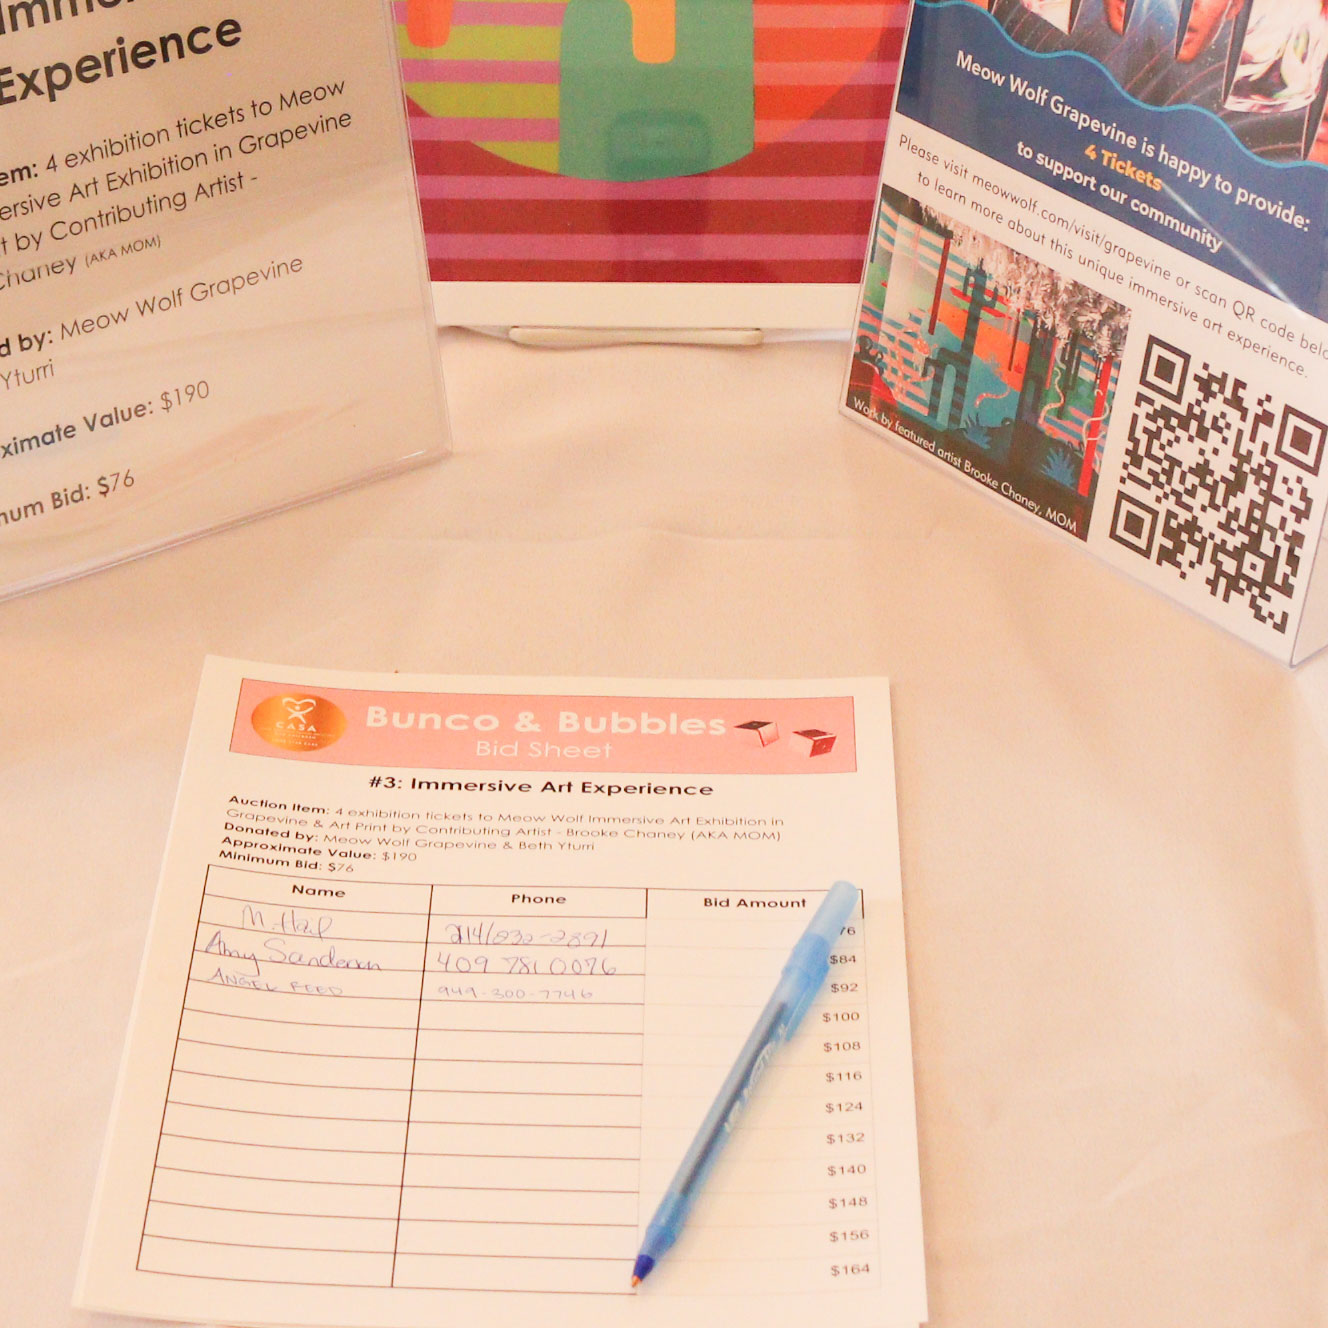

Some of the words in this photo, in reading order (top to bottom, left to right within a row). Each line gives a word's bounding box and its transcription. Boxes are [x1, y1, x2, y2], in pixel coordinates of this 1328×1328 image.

[45, 153, 58, 172] 4
[64, 127, 170, 168] exhibition
[175, 105, 245, 138] tickets
[250, 99, 272, 118] to
[279, 80, 344, 111] Meow
[955, 49, 1005, 86] Meow
[1009, 73, 1049, 106] Wolf
[1049, 94, 1137, 149] Grapevine
[1140, 136, 1155, 157] is
[1157, 143, 1212, 188] happy
[1214, 173, 1232, 194] to
[1234, 186, 1310, 232] provide:
[68, 176, 98, 202] Art
[105, 151, 208, 192] Exhibition
[212, 142, 232, 162] in
[237, 112, 351, 155] Grapevine
[1083, 143, 1097, 160] 4
[1100, 148, 1164, 191] Tickets
[1016, 140, 1033, 159] to
[1035, 152, 1096, 191] support
[1098, 183, 1128, 204] our
[1129, 198, 1225, 253] community
[898, 132, 939, 165] Please
[943, 158, 968, 179] visit
[971, 174, 1171, 280] meowwolf.com/visit/grapevine
[1175, 275, 1191, 289] or
[1194, 284, 1227, 308] scan
[1231, 299, 1255, 322] QR
[1259, 317, 1295, 342] code
[853, 397, 879, 418] Work
[881, 412, 893, 429] by
[894, 421, 935, 452] featured
[937, 447, 962, 467] artist
[964, 461, 998, 488] Brooke
[1001, 482, 1044, 515] Chaney,
[1045, 508, 1077, 532] MOM
[369, 775, 401, 789] #3:
[411, 777, 532, 792] Immersive
[540, 780, 572, 793] Art
[581, 781, 713, 796] Experience
[229, 796, 287, 810] Auction
[292, 803, 330, 814] Item:
[348, 808, 420, 820] exhibition
[426, 811, 472, 822] tickets
[478, 812, 492, 822] to
[498, 813, 546, 822] Meow
[551, 814, 584, 823] Wolf
[589, 815, 664, 824] Immersive
[670, 816, 691, 825] Art
[696, 816, 766, 826] Exhibition
[772, 818, 784, 826] in
[829, 954, 856, 965] $84
[829, 982, 858, 993] $92
[821, 1011, 860, 1023] $100
[830, 1263, 870, 1277] $164
